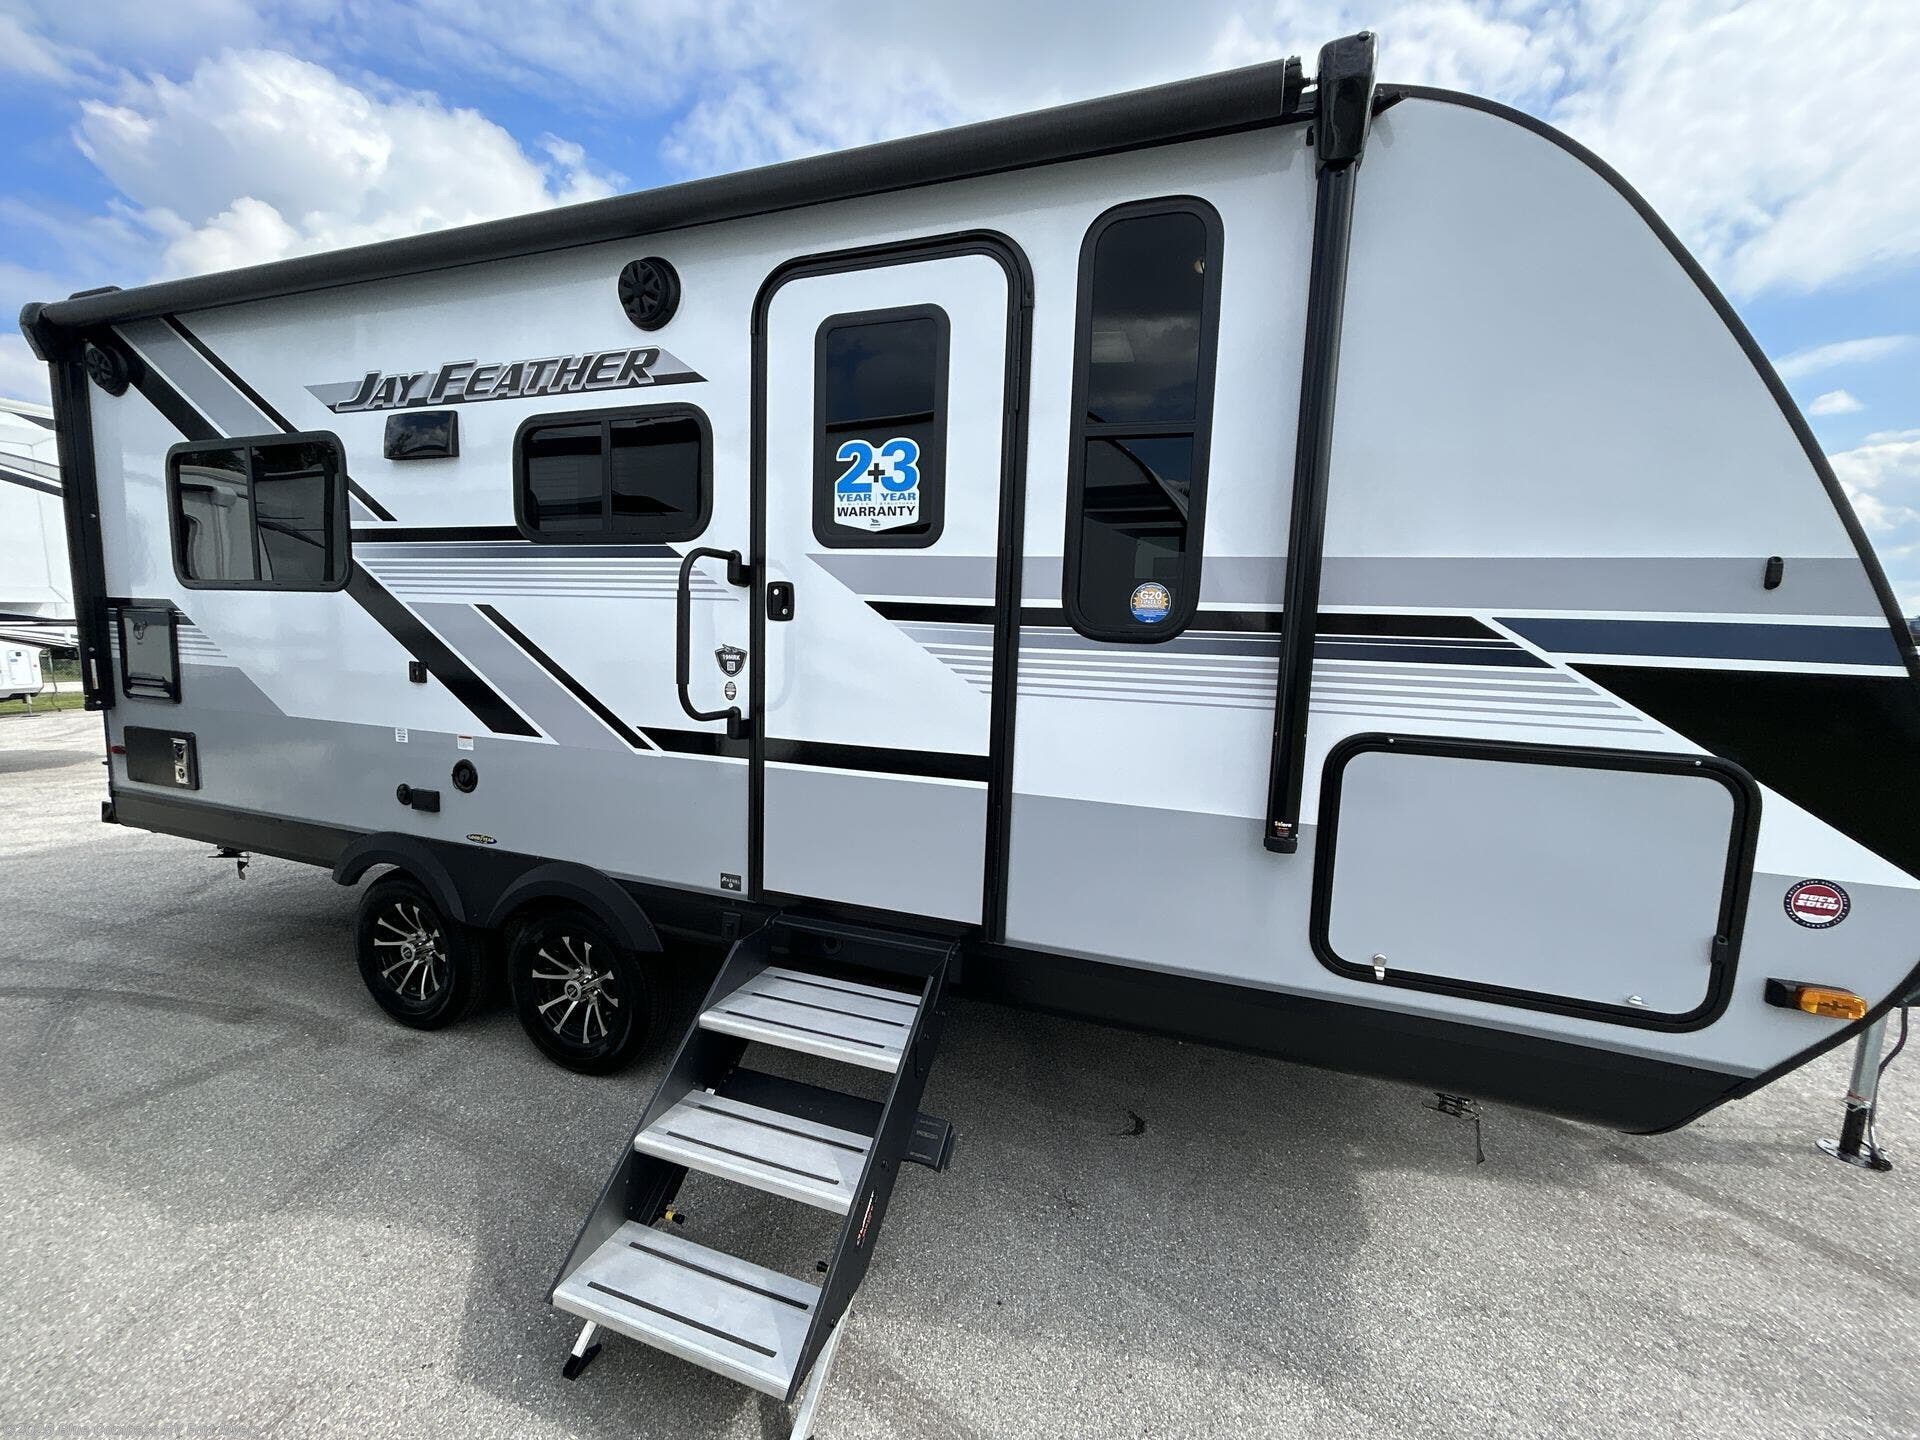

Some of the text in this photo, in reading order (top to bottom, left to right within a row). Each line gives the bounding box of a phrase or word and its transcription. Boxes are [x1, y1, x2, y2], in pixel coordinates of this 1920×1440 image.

[336, 345, 661, 410] JAY FEATHER
[838, 493, 916, 502] YEAR YEAR
[837, 506, 916, 517] WARRANTY
[1140, 590, 1162, 600] G20
[1798, 893, 1838, 904] ROCK
[1795, 899, 1839, 910] SOLID
